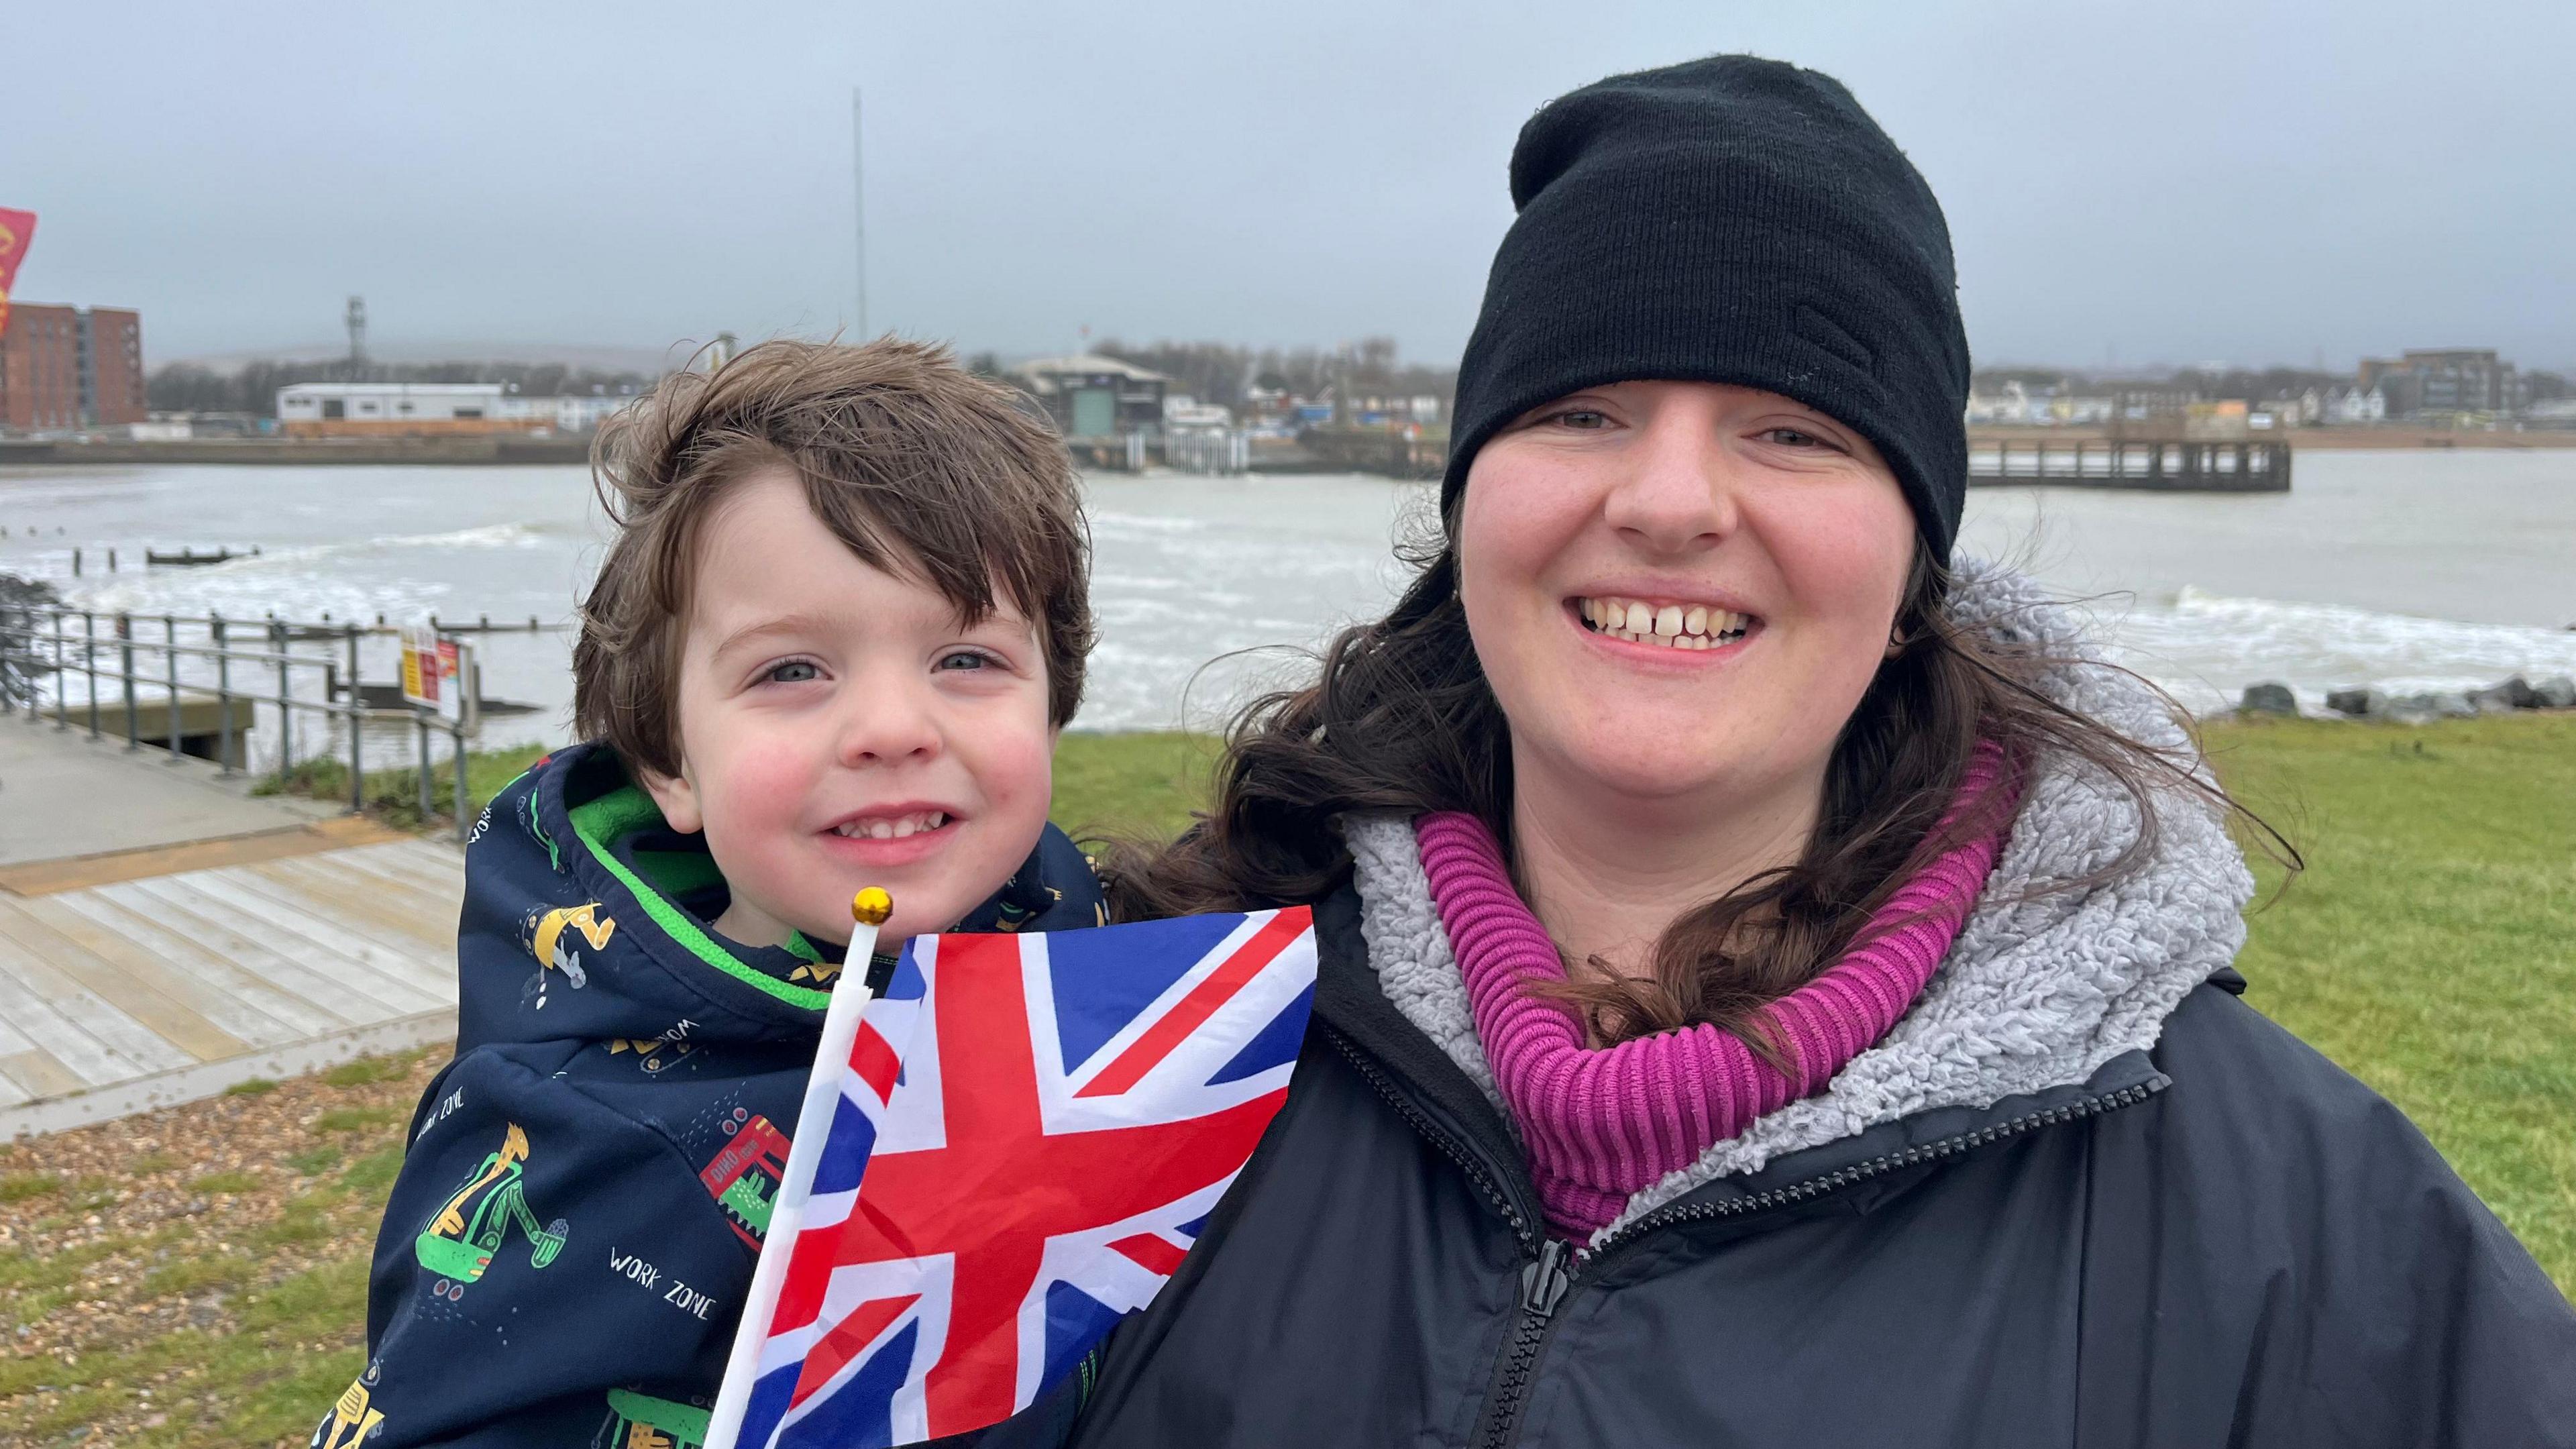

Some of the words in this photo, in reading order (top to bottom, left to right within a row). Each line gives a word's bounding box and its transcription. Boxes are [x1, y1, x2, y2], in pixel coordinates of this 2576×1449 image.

[467, 806, 492, 844] WORK
[610, 1246, 661, 1291] WORK
[663, 1279, 717, 1321] ZONE
